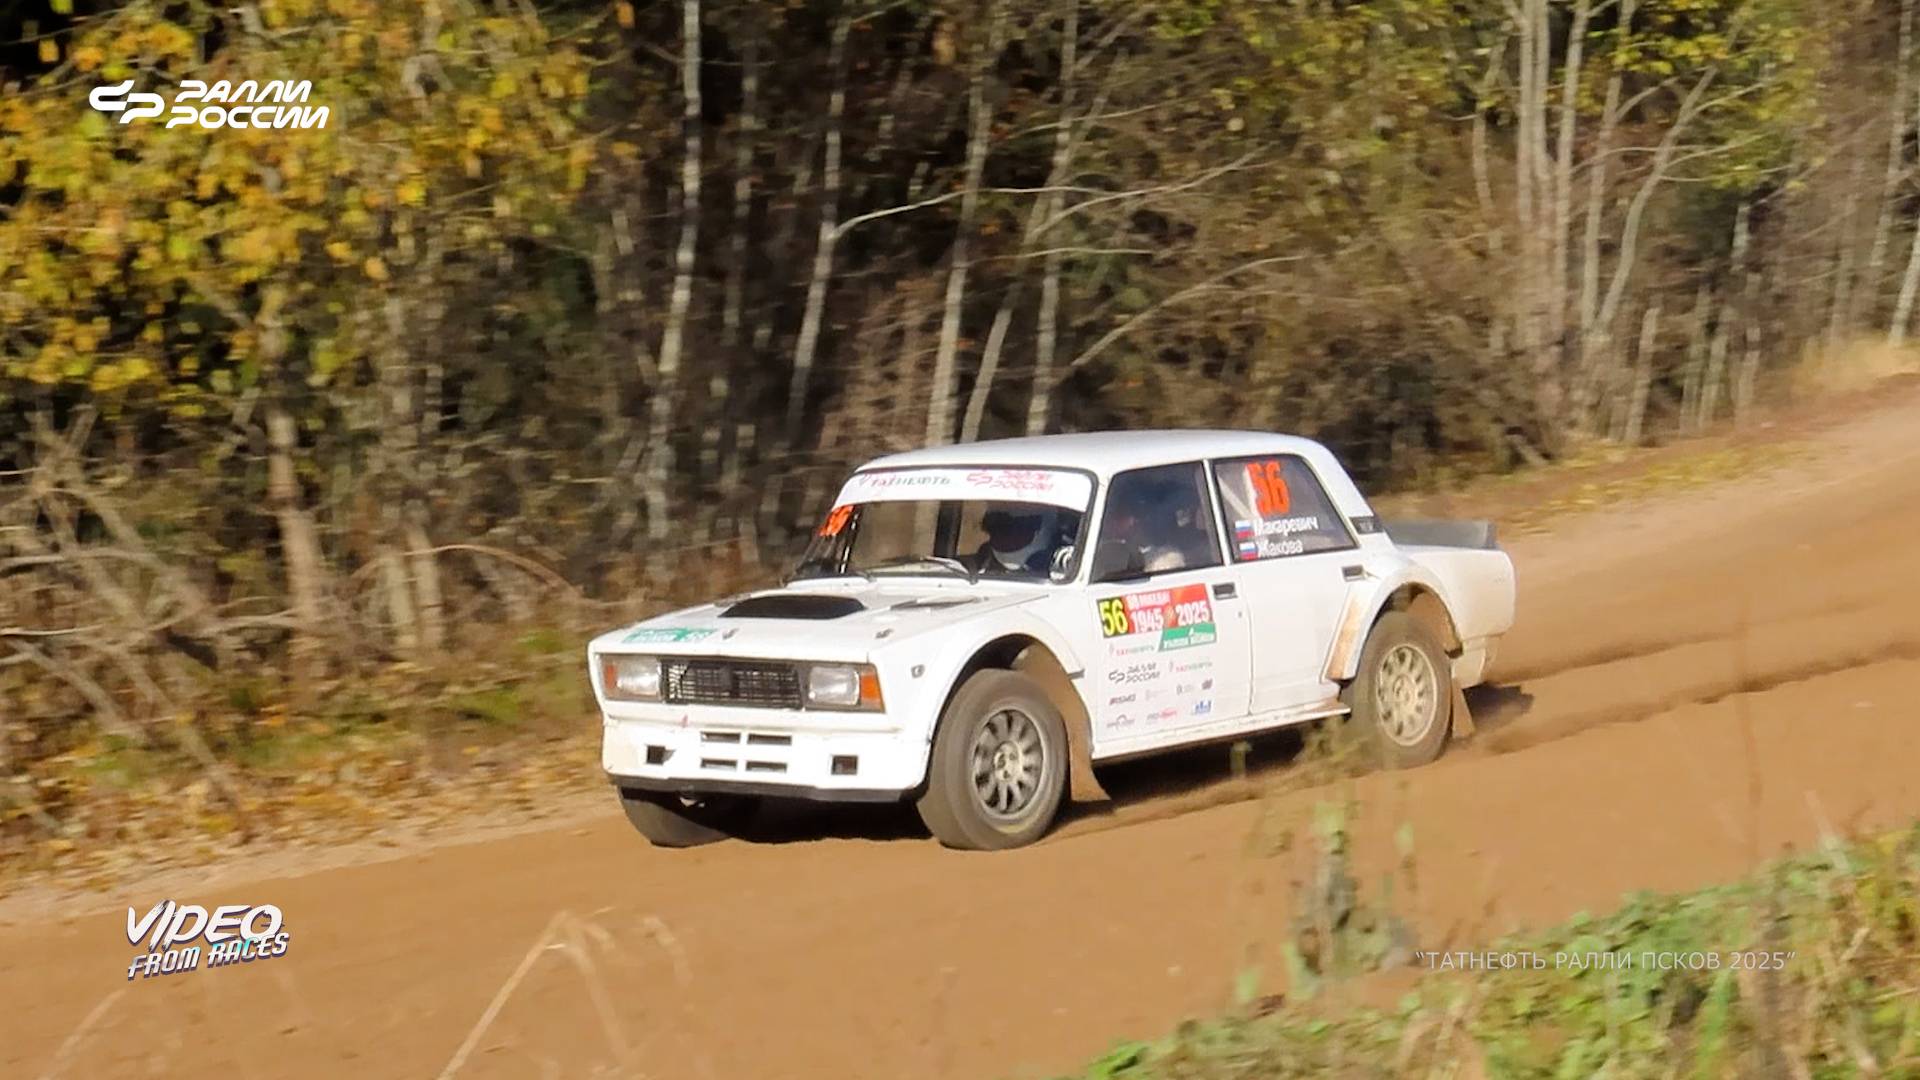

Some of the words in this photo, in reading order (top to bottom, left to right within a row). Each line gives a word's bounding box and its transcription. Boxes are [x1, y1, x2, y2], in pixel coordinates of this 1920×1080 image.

[1246, 460, 1290, 515] 56
[1099, 598, 1129, 637] 56
[1130, 606, 1164, 635] 1945
[1175, 600, 1210, 626] 2025
